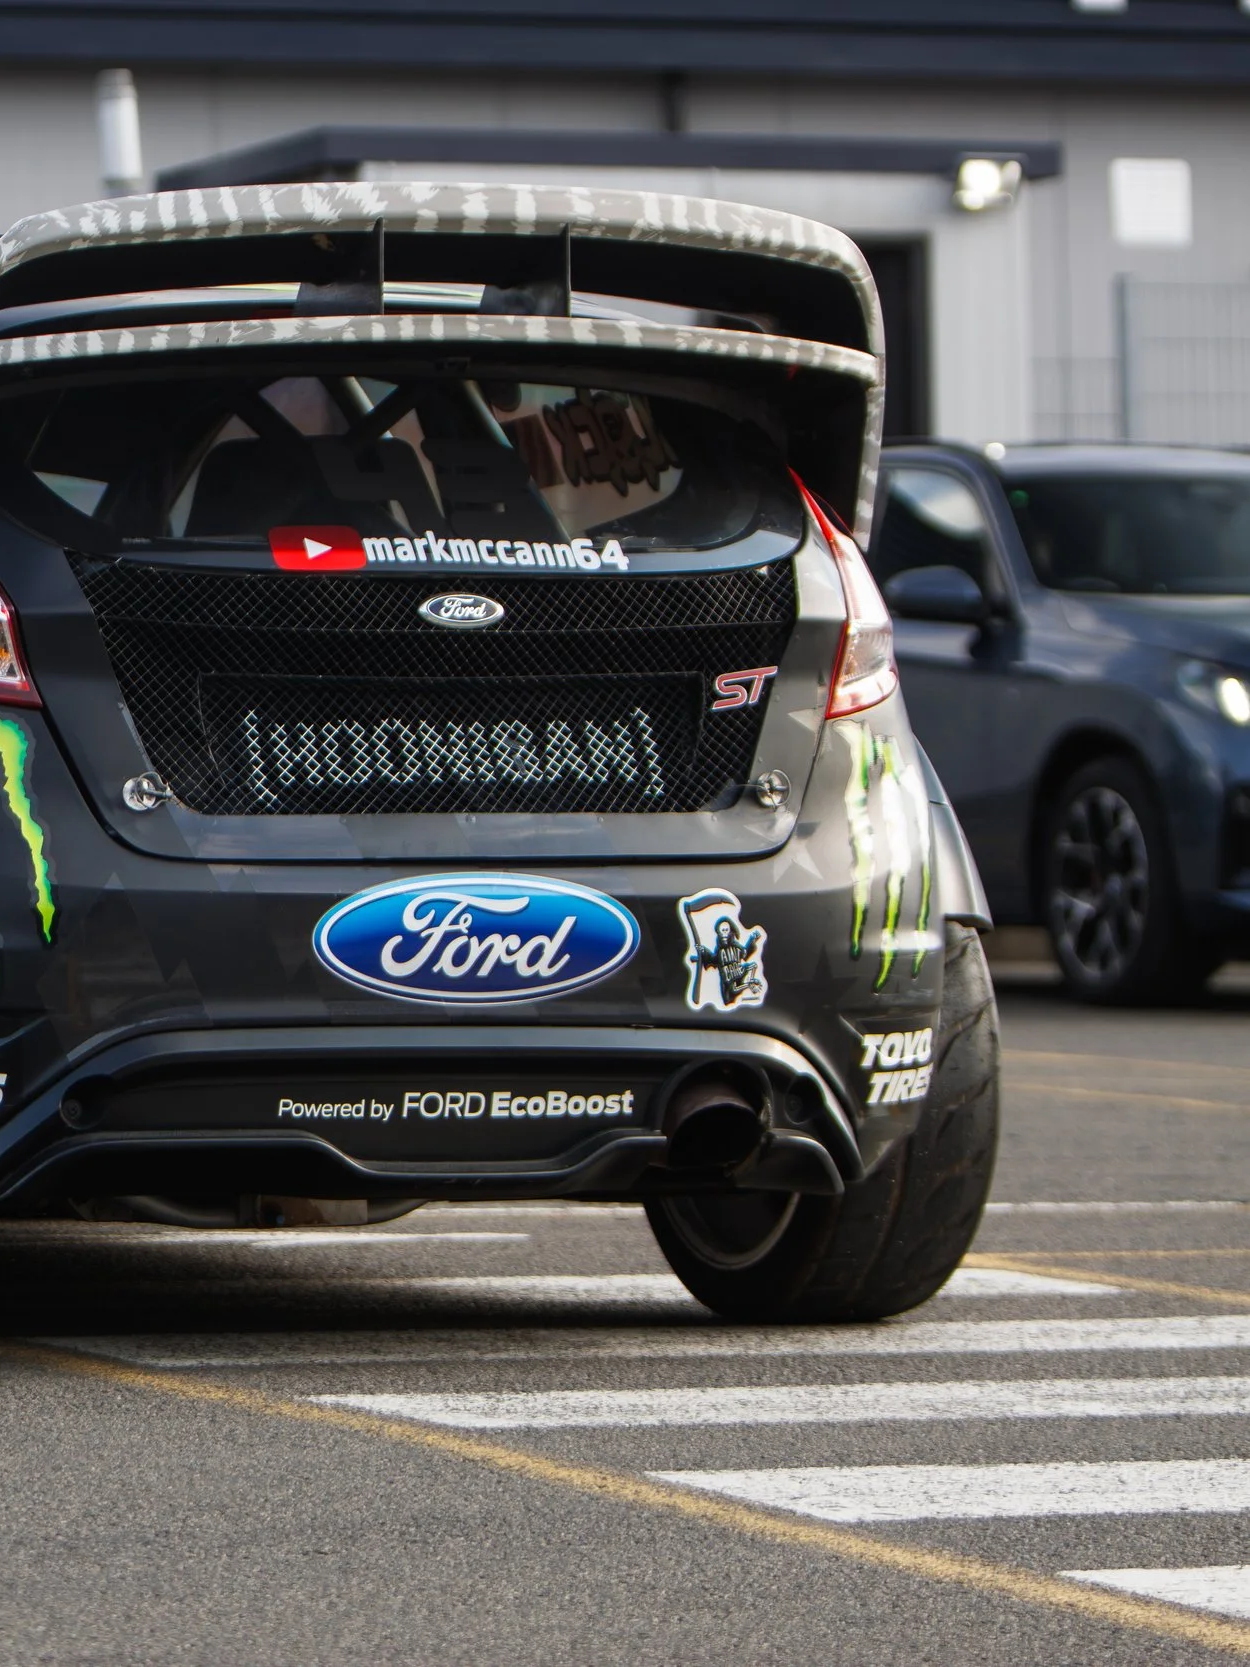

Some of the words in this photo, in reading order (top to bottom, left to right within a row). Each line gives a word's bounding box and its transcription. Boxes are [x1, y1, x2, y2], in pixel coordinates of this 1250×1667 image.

[362, 530, 629, 571] markmccann64
[439, 597, 486, 618] Ford
[712, 667, 777, 710] ST
[381, 893, 577, 977] Ford
[860, 1027, 933, 1068] TOYO
[278, 1099, 365, 1117] Powered
[370, 1099, 394, 1121] by
[402, 1091, 486, 1117] FORD
[490, 1089, 634, 1117] EcoBoost
